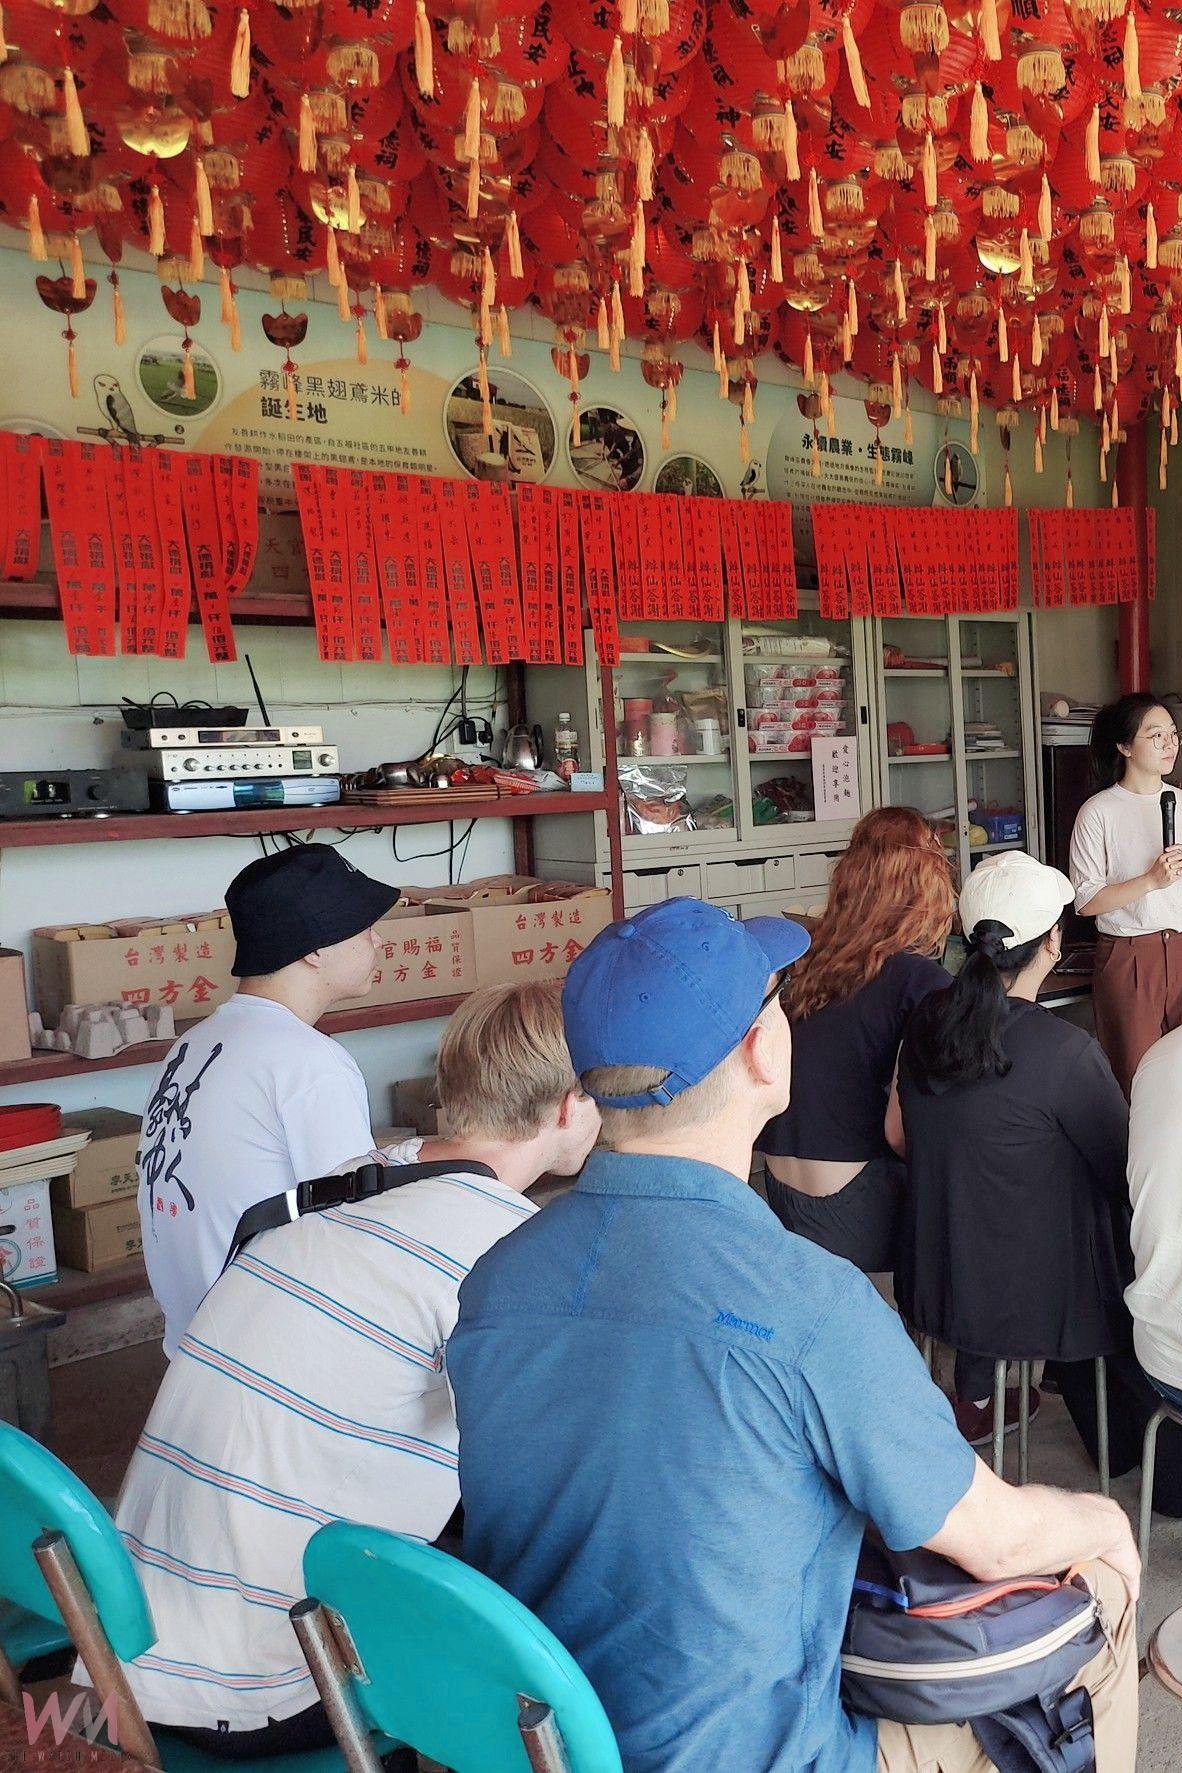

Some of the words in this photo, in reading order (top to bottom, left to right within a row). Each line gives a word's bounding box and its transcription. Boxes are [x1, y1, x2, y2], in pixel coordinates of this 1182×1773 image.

[515, 910, 582, 930] 台灣製造
[124, 941, 213, 967] 台灣製造
[450, 930, 462, 977] 品質保證
[512, 938, 585, 966] 四方金
[121, 975, 219, 1005] 四方金
[24, 1198, 45, 1270] 品質保證
[713, 1311, 775, 1341] Marmot
